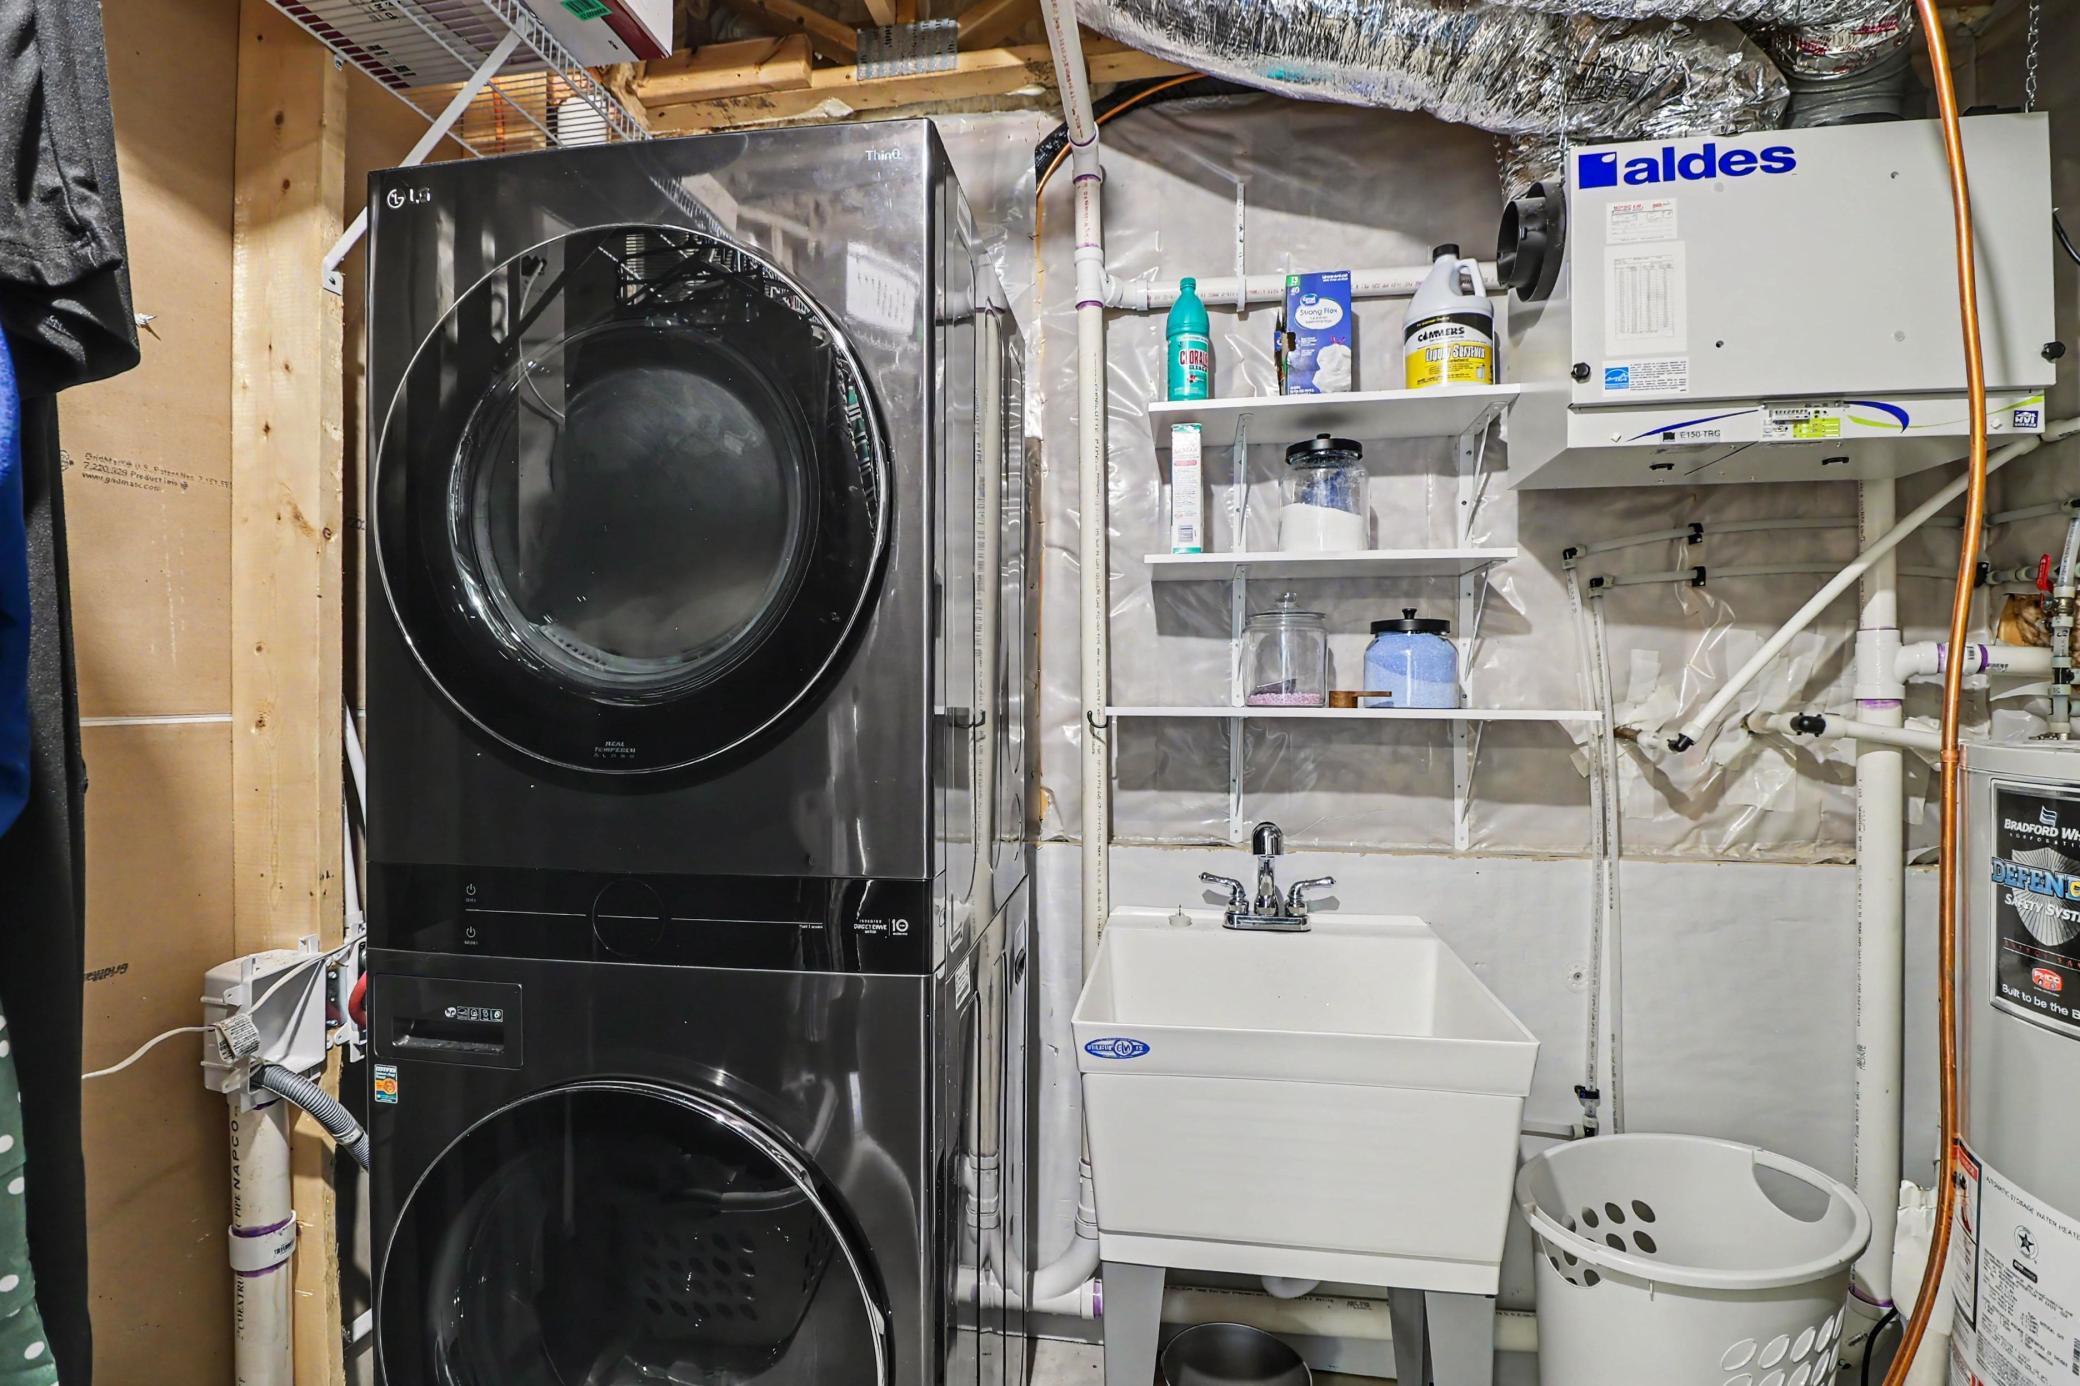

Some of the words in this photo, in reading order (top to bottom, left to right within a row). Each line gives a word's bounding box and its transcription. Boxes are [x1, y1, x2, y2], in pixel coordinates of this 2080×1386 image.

[865, 149, 902, 161] ThinQ
[1623, 142, 1797, 186] aldes
[2004, 818, 2059, 837] BRADFORD
[2004, 893, 2043, 913] SAFETY
[2002, 984, 2020, 998] Built
[2022, 991, 2032, 1003] to
[2034, 996, 2047, 1009] be
[2050, 1002, 2069, 1016] the
[231, 1119, 241, 1190] NAPCO
[2036, 1211, 2057, 1227] WATER
